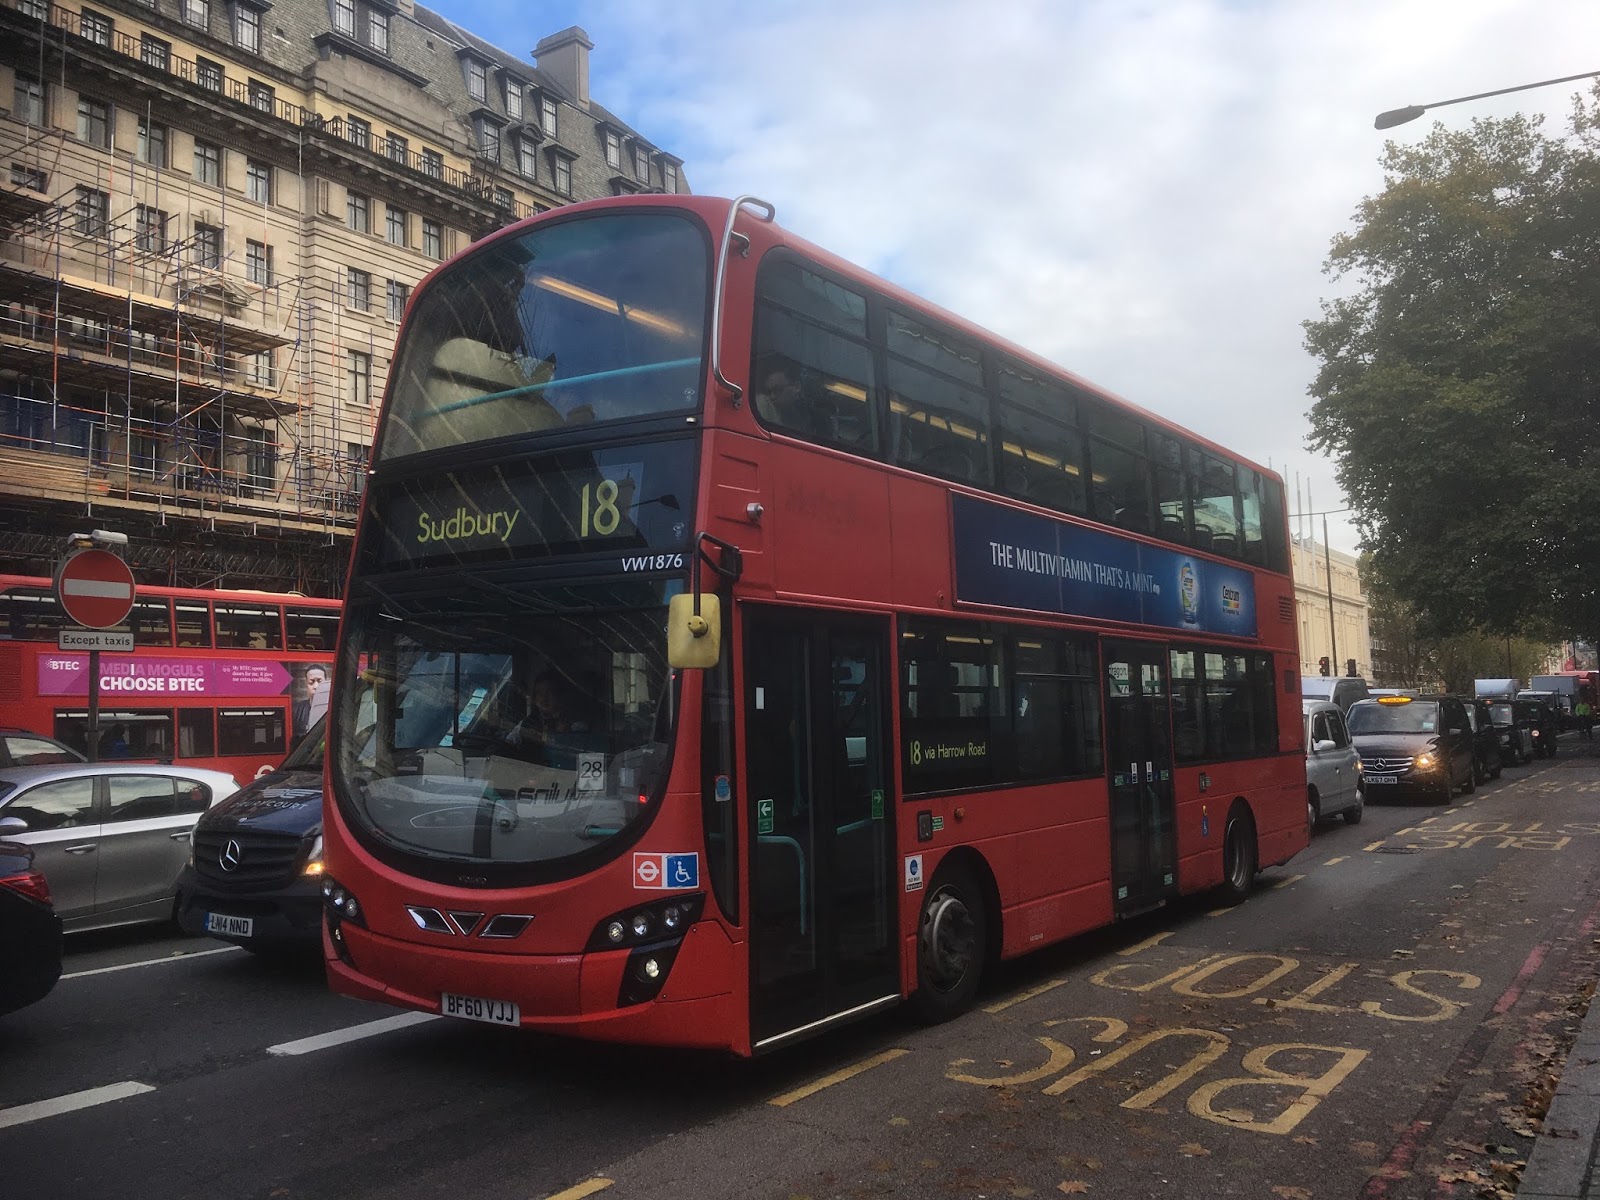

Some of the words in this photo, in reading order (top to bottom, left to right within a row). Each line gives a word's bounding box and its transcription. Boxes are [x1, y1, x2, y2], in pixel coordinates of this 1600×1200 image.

[580, 479, 620, 537] 18
[417, 508, 520, 542] Sudbury
[621, 553, 683, 573] VW1876
[990, 541, 1014, 568] THE
[1016, 547, 1092, 583] MULTIVITAMIN
[1094, 563, 1123, 588] THAT'S
[1125, 571, 1132, 590] A
[1222, 585, 1240, 602] Centrum
[63, 635, 100, 646] Except
[105, 636, 130, 646] taxis
[52, 661, 80, 670] BTEC
[100, 663, 146, 676] MEDIA
[148, 664, 204, 677] MOGULS
[99, 677, 165, 691] CHOOSE
[168, 678, 204, 691] BTEC
[910, 740, 921, 765] 18
[924, 746, 936, 759] via
[937, 743, 966, 759] Harrow
[968, 741, 985, 756] Road
[580, 761, 602, 779] 28
[1406, 834, 1573, 850] BUS
[230, 918, 249, 934] NND
[1088, 954, 1482, 1023] STOP
[447, 995, 482, 1018] BF60
[486, 1000, 515, 1023] VJJ
[944, 1016, 1371, 1135] BUS
